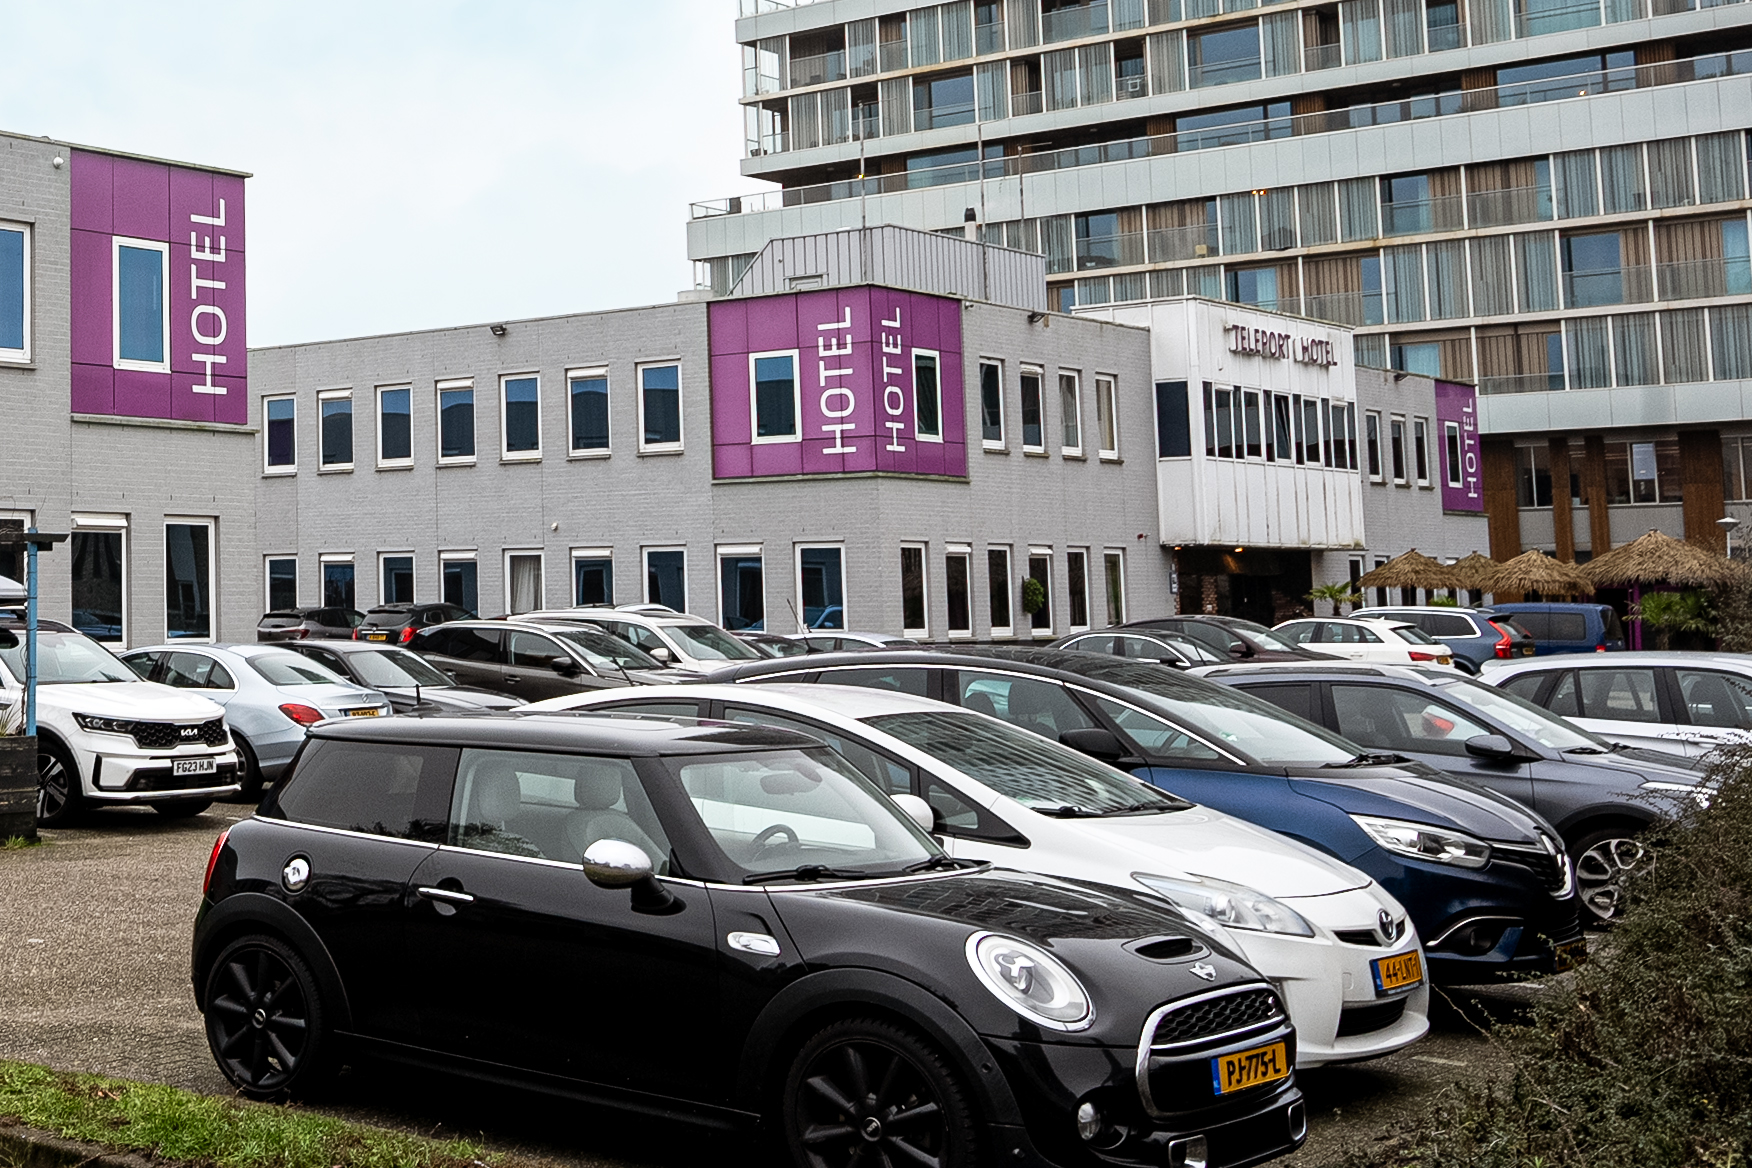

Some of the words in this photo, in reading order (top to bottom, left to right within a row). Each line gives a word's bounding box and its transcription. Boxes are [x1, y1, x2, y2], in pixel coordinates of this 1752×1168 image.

[190, 198, 228, 395] HOTEL
[1226, 324, 1291, 359] TELEPORT
[1294, 336, 1338, 366] HOTEL
[817, 306, 857, 455] HOTEL
[881, 307, 906, 452] HOTEL
[1462, 398, 1478, 498] HOTEL
[176, 761, 197, 773] FG23
[199, 760, 214, 772] HJN
[1226, 1048, 1282, 1087] PJ-775-L
